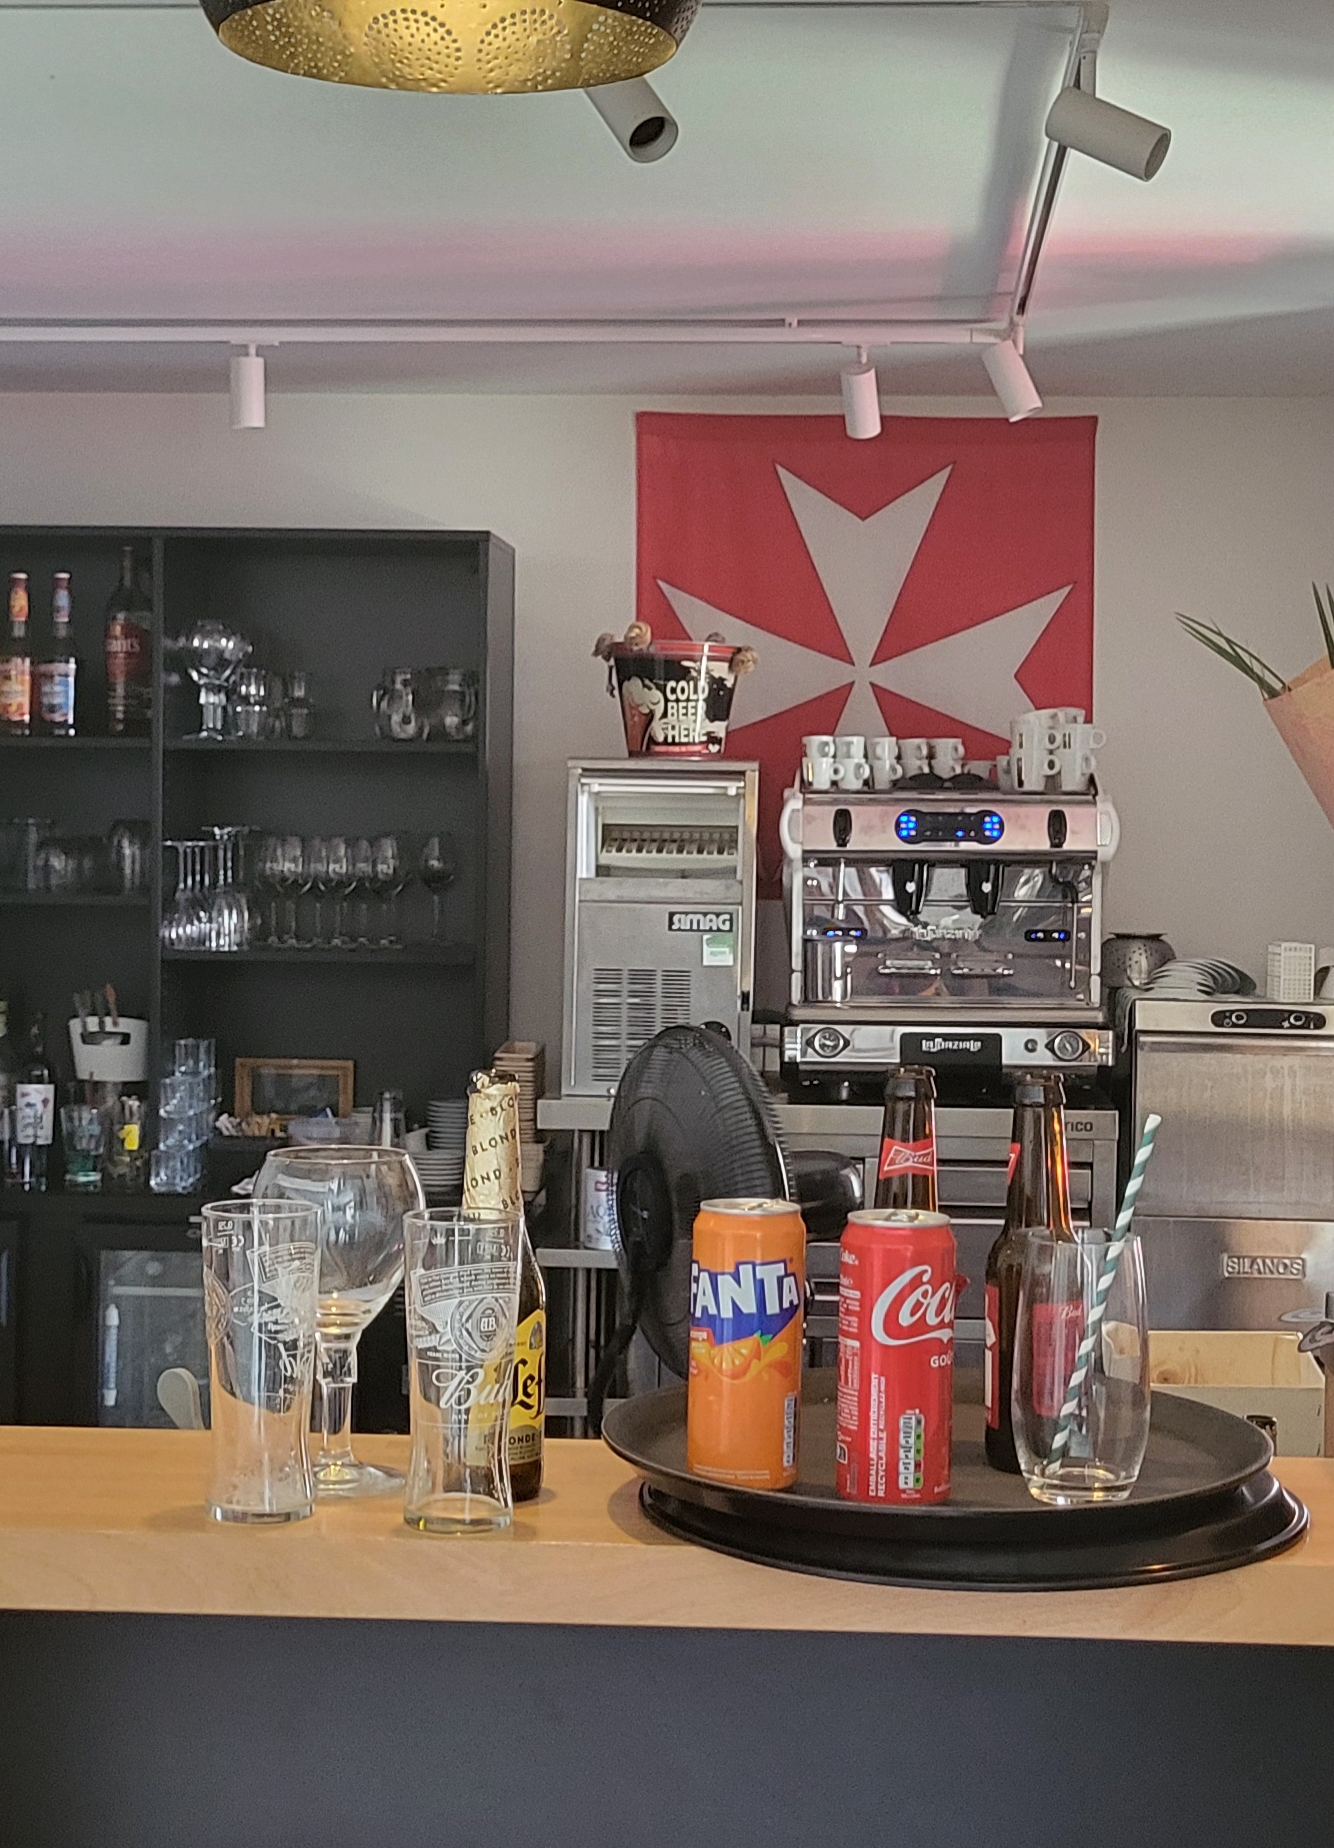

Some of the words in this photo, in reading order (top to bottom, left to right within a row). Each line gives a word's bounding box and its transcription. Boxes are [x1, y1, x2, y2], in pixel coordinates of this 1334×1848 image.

[666, 680, 709, 700] COLD
[667, 701, 707, 720] BEER
[667, 724, 708, 742] HERE
[671, 914, 731, 930] SIMAG
[1227, 1257, 1303, 1275] SILANOS
[691, 1262, 799, 1318] FANTA
